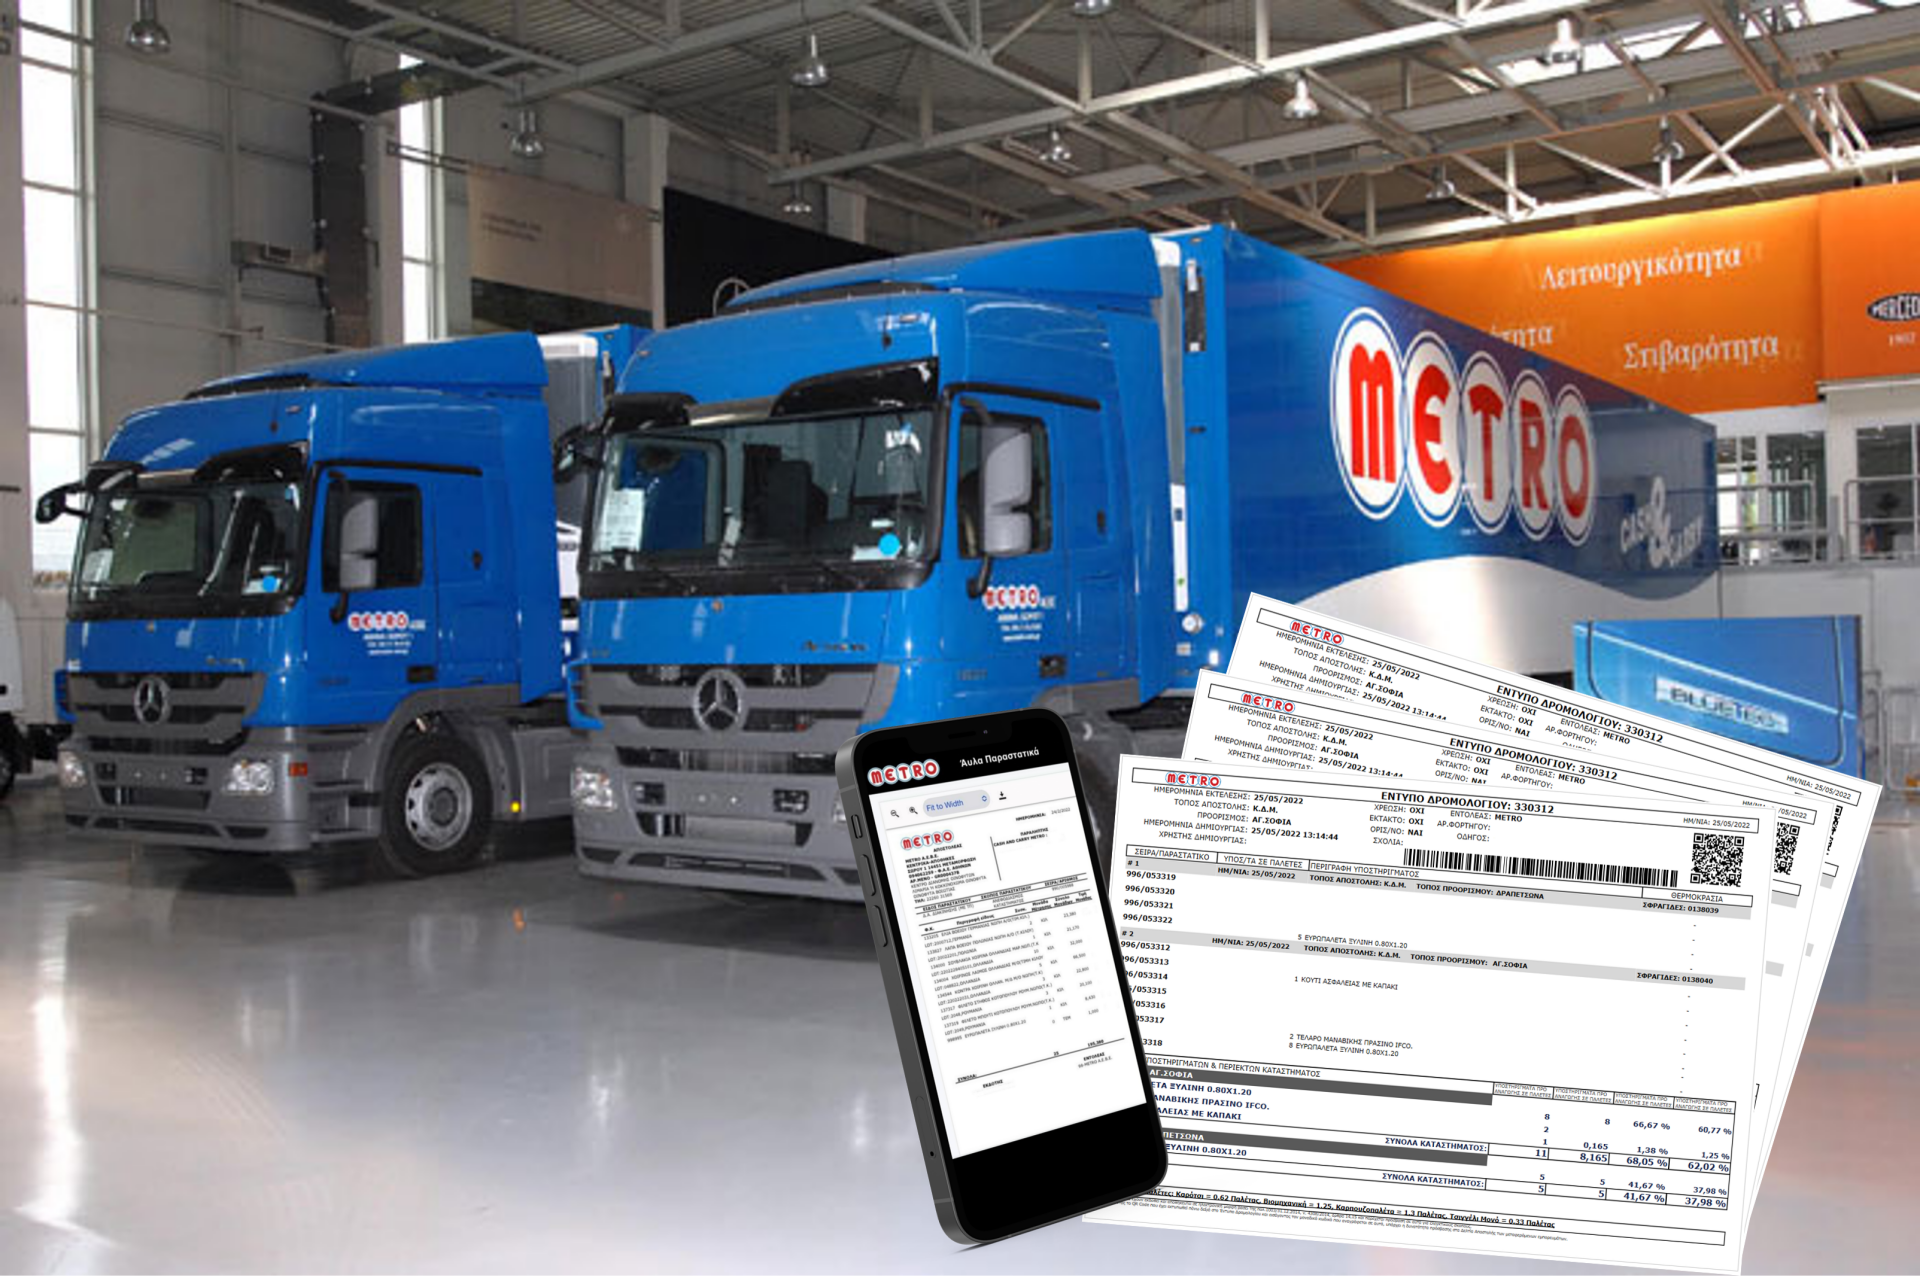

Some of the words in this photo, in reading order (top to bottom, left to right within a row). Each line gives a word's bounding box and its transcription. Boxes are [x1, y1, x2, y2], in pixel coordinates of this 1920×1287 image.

[1540, 243, 1743, 290] Λειτουργικότητα
[1623, 333, 1779, 373] Στιβαρότητα
[1347, 341, 1592, 520] METRO
[982, 584, 1040, 610] METRO
[348, 611, 409, 632] METRO
[1290, 621, 1342, 644] METRO
[1275, 630, 1324, 651] ΗΜΕΡΟΜΗΝΙΑ
[1325, 645, 1369, 664] ΕΚΤΕΛΕΣΗΣ:
[1371, 659, 1420, 680] 25/05/2022
[1293, 646, 1318, 661] ΤΟΠΟΣ
[1318, 655, 1366, 675] ΑΠΟΣΤΟΛΗΣ:
[1368, 670, 1393, 684] Κ.Δ.Μ.
[1312, 664, 1363, 686] ΠΡΟΟΡΙΣΜΟΣ:
[1365, 681, 1403, 698] ΑΓ.ΣΟΦΙΑ
[1241, 693, 1295, 712] METRO
[1496, 684, 1539, 704] ΕΝΤΥΠΟ
[1540, 699, 1621, 730] ΔΡΟΜΟΛΟΓΙΟΥ:
[1624, 724, 1663, 743] 330312
[1228, 704, 1276, 720] ΗΜΕΡΟΜΗΝΙΑ
[1278, 714, 1322, 729] ΕΚΤΕΛΕΣΗΣ:
[1324, 724, 1373, 740] 25/05/2022
[1246, 718, 1272, 730] ΤΟΠΟΣ
[1272, 724, 1320, 740] ΑΠΟΣΤΟΛΗΣ:
[1322, 735, 1347, 746] Κ.Δ.Μ.
[959, 756, 983, 767] Άυλα
[984, 746, 1039, 763] Παραστατικά
[1449, 737, 1492, 753] ΕΝΤΥΠΟ
[1493, 747, 1575, 771] ΔΡΟΜΟΛΟΓΙΟΥ:
[1578, 764, 1617, 780] 330312
[870, 762, 937, 787] METRO
[1165, 773, 1221, 787] METRO
[1786, 774, 1813, 788] ΗΜ/ΝΙΑ:
[1814, 783, 1851, 800] 25/05/2022
[1153, 785, 1203, 796] ΗΜΕΡΟΜΗΝΙΑ
[1205, 789, 1250, 800] ΕΚΤΕΛΕΣΗΣ:
[1253, 793, 1303, 804] 25/05/2022
[943, 799, 964, 808] Width
[1173, 798, 1200, 807] ΤΟΠΟΣ
[1201, 800, 1249, 811] ΑΠΟΣΤΟΛΗΣ:
[1252, 805, 1278, 813] Κ.Δ.Μ.
[1373, 803, 1406, 813] ΧΡΕΩΣΗ:
[1409, 806, 1424, 814] ΟΧΙ
[1381, 791, 1425, 803] ΕΝΤΥΠΟ
[1427, 795, 1511, 810] ΔΡΟΜΟΛΟΓΙΟΥ:
[1514, 802, 1554, 814] 330312
[1197, 811, 1248, 822] ΠΡΟΟΡΙΣΜΟΣ:
[1251, 816, 1291, 826] ΑΓ.ΣΟΦΙΑ
[1369, 814, 1405, 824] ΕΚΤΑΚΤΟ:
[1408, 817, 1423, 825] ΟΧΙ
[1450, 809, 1491, 820] ΕΝΤΟΛΕΑΣ:
[1494, 813, 1523, 822] METRO
[1143, 818, 1193, 828] ΗΜΕΡΟΜΗΝΙΑ
[1194, 822, 1247, 833] ΔΗΜΙΟΥΡΓΙΑΣ:
[1251, 826, 1301, 837] 25/05/2022
[1303, 831, 1338, 840] 13:14:44
[1436, 820, 1490, 830] ΑΡ.ΦΟΡΤΗΓΟΥ:
[1683, 817, 1710, 825] ΗΜ/ΝΙΑ:
[1712, 819, 1750, 829] 25/05/2022
[1158, 830, 1192, 840] ΧΡΗΣΤΗΣ
[1193, 833, 1246, 844] ΔΗΜΙΟΥΡΓΙΑΣ:
[1369, 825, 1404, 835] ΟΡΙΣ/ΝΟ:
[1407, 828, 1423, 836] ΝΑΙ
[1456, 832, 1490, 842] ΟΔΗΓΟΣ:
[902, 831, 952, 849] METRO
[1372, 836, 1403, 846] ΣΧΟΛΙΑ:
[1134, 847, 1210, 861] ΣΕΙΡΑ/ΠΑΡΑΣΤΑΤΙΚΟ
[1223, 855, 1256, 865] ΥΠΟΣ/ΤΑ
[1269, 858, 1303, 868] ΠΑΛΕΤΕΣ
[1126, 870, 1176, 880] 996/053319
[1217, 867, 1249, 875] ΗΜ/ΝΙΑ:
[1251, 869, 1295, 879] 25/05/2022
[1310, 862, 1352, 872] ΠΕΡΙΓΡΑΦΗ
[1353, 865, 1419, 878] ΥΠΟΣΤΗΡΙΓΜΑΤΟΣ
[1309, 874, 1334, 882] ΤΟΠΟΣ
[1335, 876, 1382, 886] ΑΠΟΣΤΟΛΗΣ:
[1383, 880, 1406, 888] Κ.Δ.Μ.
[1125, 884, 1175, 895] 996/053320
[1416, 883, 1440, 891] ΤΟΠΟΣ
[1442, 885, 1493, 895] ΠΡΟΟΡΙΣΜΟΥ:
[1495, 889, 1544, 899] ΔΡΑΠΕΤΣΩΝΑ
[1670, 891, 1723, 902] ΘΕΡΜΟΚΡΑΣΙΑ
[1123, 898, 1173, 909] 996/053321
[1642, 901, 1685, 911] ΣΦΡΑΓΙΔΕΣ:
[1687, 905, 1719, 913] 0138039
[1122, 913, 1172, 924] 996/053322
[1119, 940, 1170, 951] 996/053312
[1304, 934, 1347, 943] ΕΥΡΩΠΑΛΕΤΑ
[1348, 937, 1373, 945] ΞΥΛΙΝΗ
[1374, 940, 1408, 949] 0.80X1.20
[1492, 960, 1528, 969] ΑΓ.ΣΟΦΙΑ
[1300, 976, 1321, 984] ΚΟΥΤΙ
[1322, 978, 1360, 987] ΑΣΦΑΛΕΙΑΣ
[1372, 982, 1398, 990] ΚΑΠΑΚΙ
[1636, 972, 1680, 981] ΣΦΡΑΓΙΔΕΣ:
[1681, 975, 1713, 984] 0138040
[1296, 1033, 1322, 1042] ΤΕΛΑΡΟ
[1323, 1036, 1362, 1045] ΜΑΝΑΒΙΚΗΣ
[1363, 1039, 1394, 1048] ΠΡΑΣΙΝΟ
[1395, 1041, 1413, 1049] IFCO.
[1149, 1068, 1193, 1079] ΑΓ.ΣΟΦΙΑ
[1210, 1061, 1217, 1069] &
[1218, 1062, 1260, 1073] ΠΕΡΙΕΚΤΩΝ
[1262, 1066, 1320, 1078] ΚΑΤΑΣΤΗΜΑΤΟΣ
[1632, 1120, 1658, 1130] 66,67
[1697, 1125, 1721, 1134] 60,77
[1384, 1137, 1418, 1146] ΣΥΝΟΛΑ
[1420, 1140, 1487, 1152] ΚΑΤΑΣΤΗΜΑΤΟΣ:
[1582, 1141, 1608, 1150] 0,165
[1535, 1149, 1546, 1157] 11
[1579, 1152, 1608, 1164] 8,165
[1626, 1156, 1654, 1167] 68,05
[1687, 1161, 1715, 1172] 62,02
[1623, 1192, 1653, 1203] 41,67
[1684, 1196, 1714, 1209] 37,98
